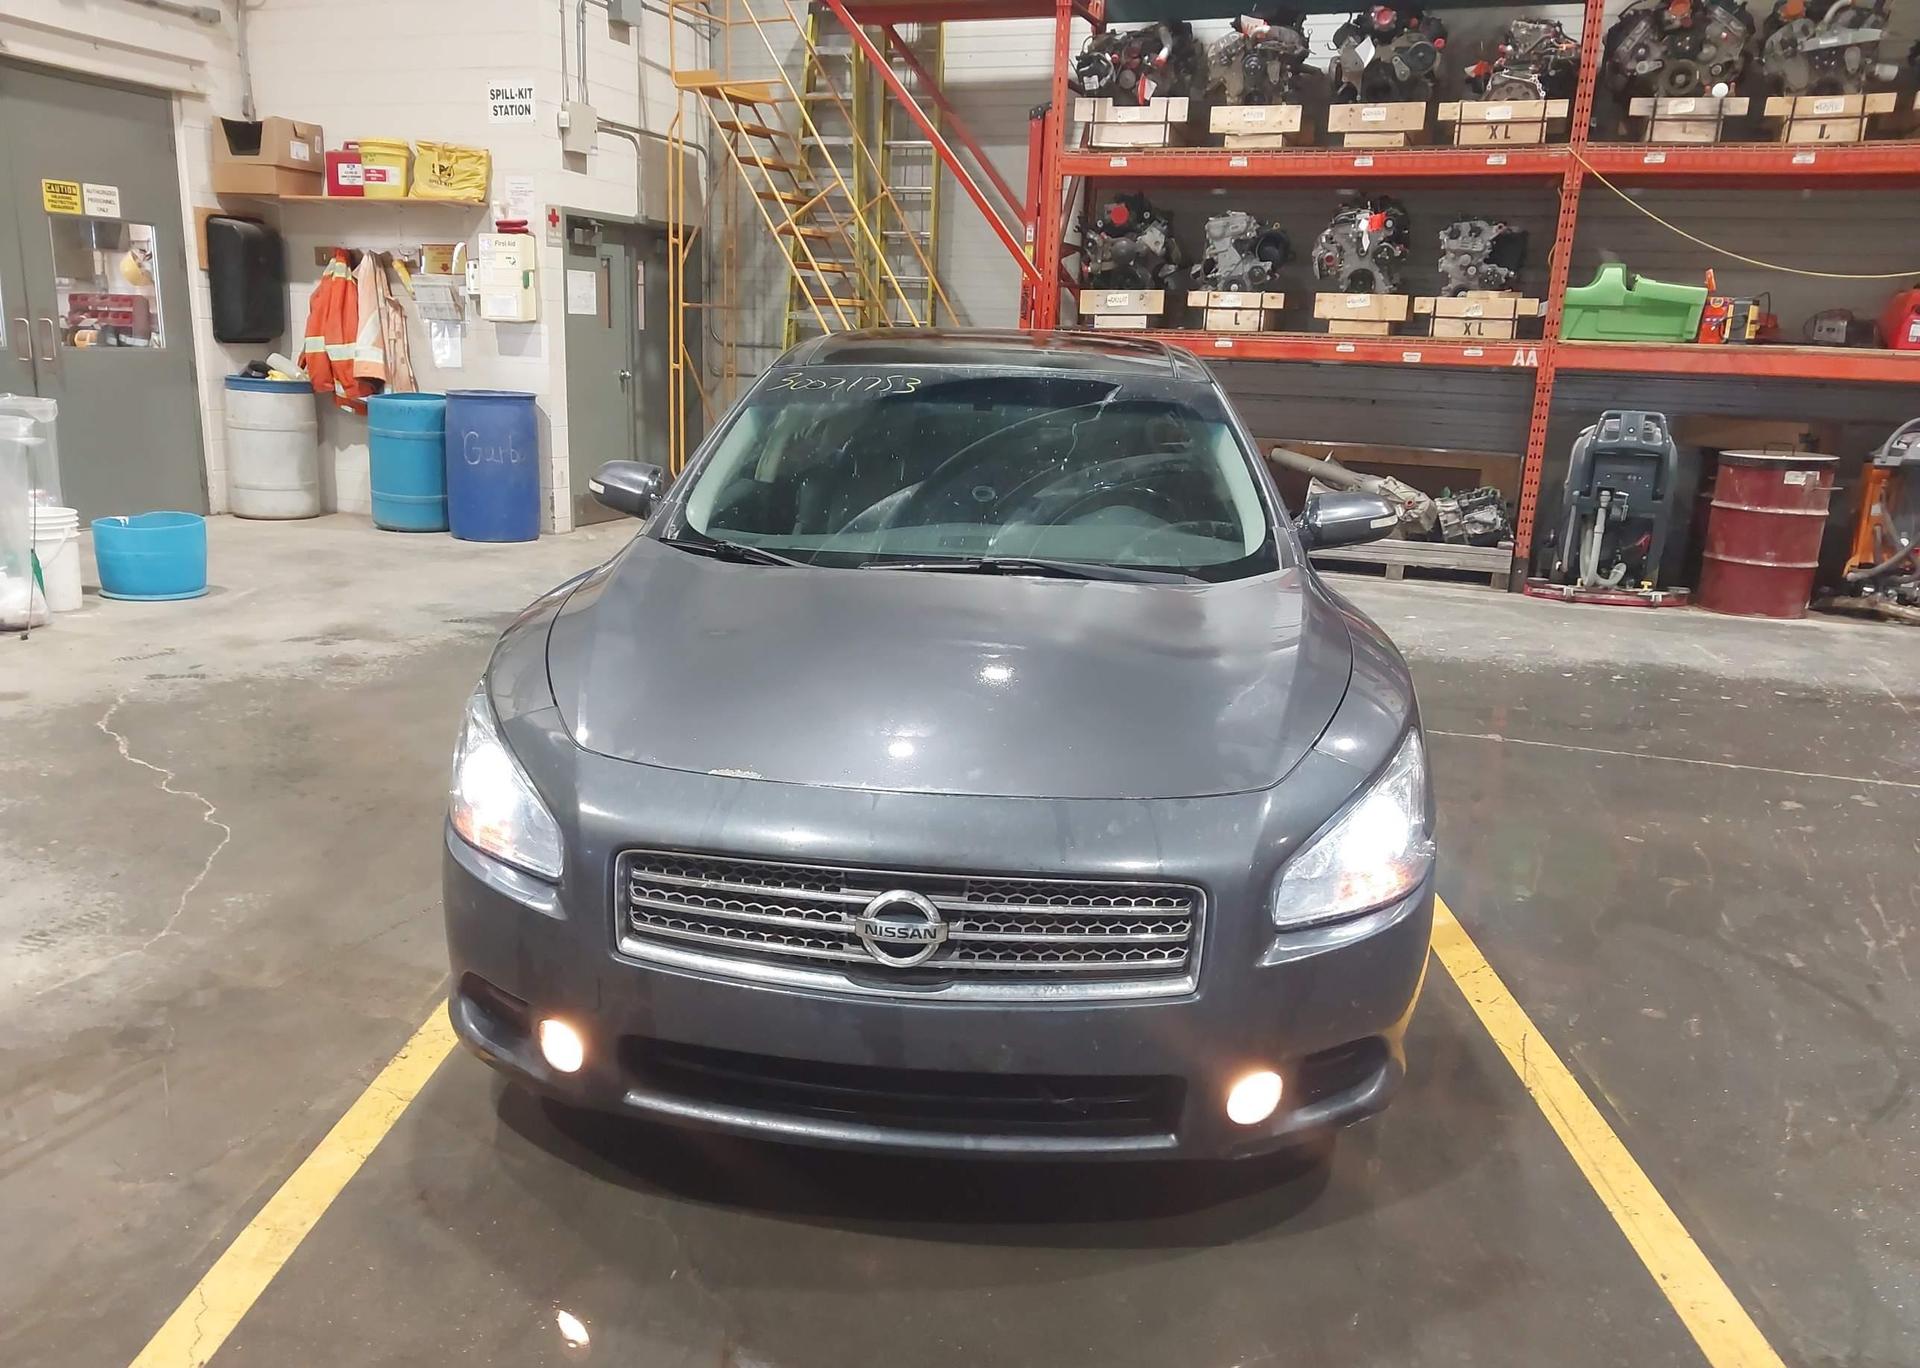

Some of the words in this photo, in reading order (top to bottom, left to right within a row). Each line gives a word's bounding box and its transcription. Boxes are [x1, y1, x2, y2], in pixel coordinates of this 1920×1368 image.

[493, 104, 531, 116] STATION
[46, 184, 77, 195] CAUTION
[1512, 347, 1539, 367] AA
[864, 923, 937, 939] NISSAN
